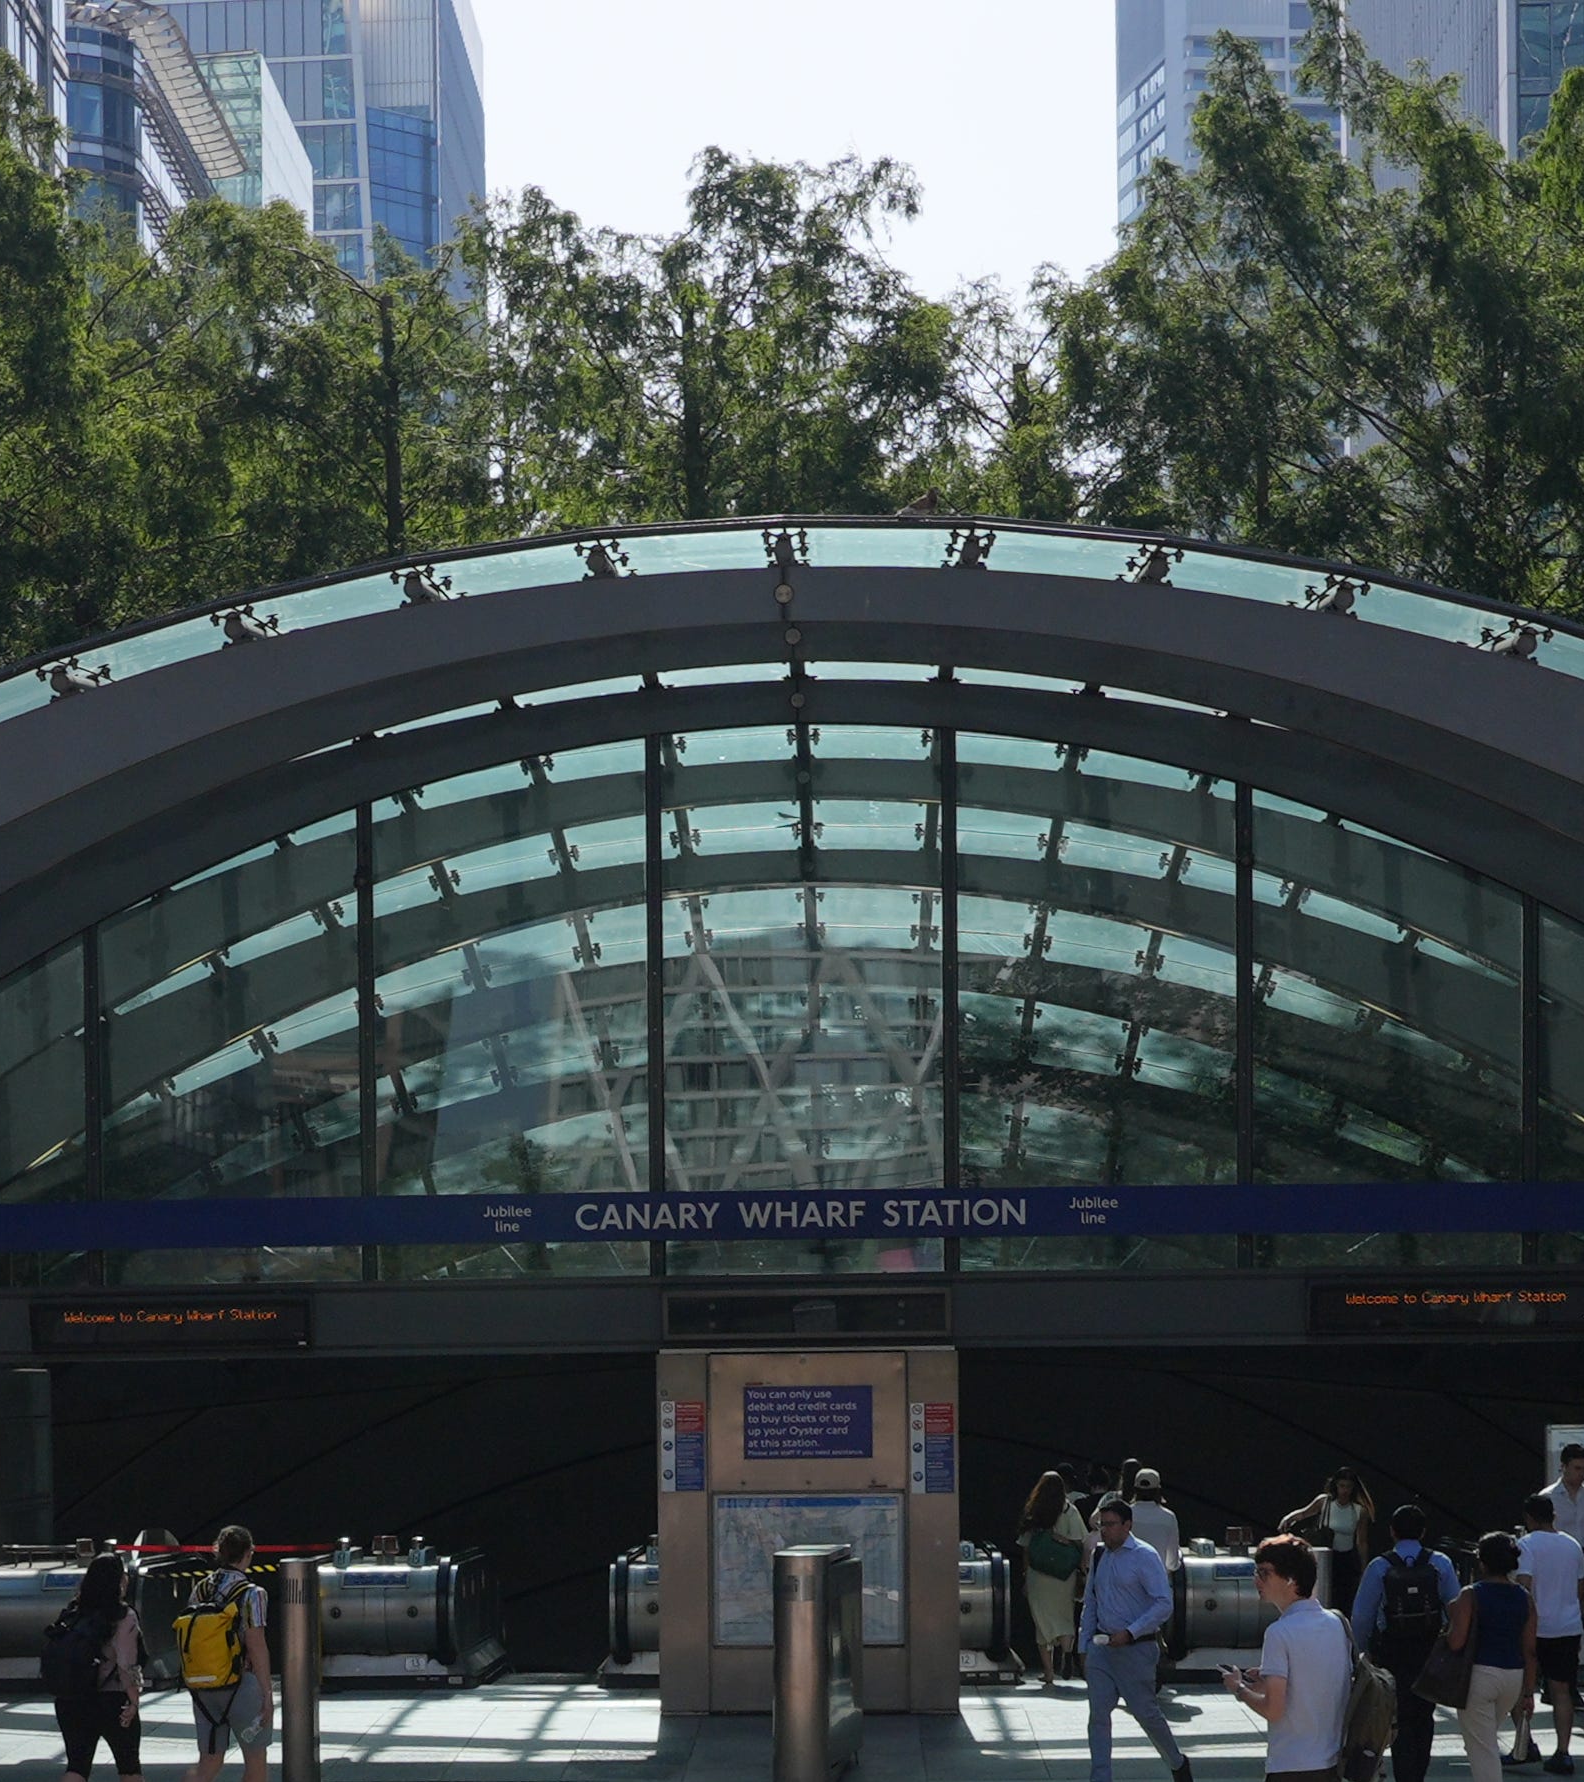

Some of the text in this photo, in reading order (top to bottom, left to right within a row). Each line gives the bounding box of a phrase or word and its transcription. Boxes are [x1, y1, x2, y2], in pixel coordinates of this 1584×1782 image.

[1069, 1196, 1119, 1211] Jubilee
[483, 1205, 532, 1218] Jubilee
[575, 1198, 1027, 1231] CANARY WHARF STATION
[1080, 1210, 1107, 1225] line
[494, 1219, 521, 1234] line
[1345, 1289, 1567, 1306] Welcome to Canary Wharf Station
[63, 1308, 278, 1325] Welcome to Canary Wharf Station
[747, 1389, 832, 1400] You can only use
[747, 1401, 857, 1412] debit and credit cards
[747, 1414, 851, 1425] to buy tickets or top
[747, 1425, 848, 1438] up your Oyster card
[747, 1438, 820, 1448] at this station.
